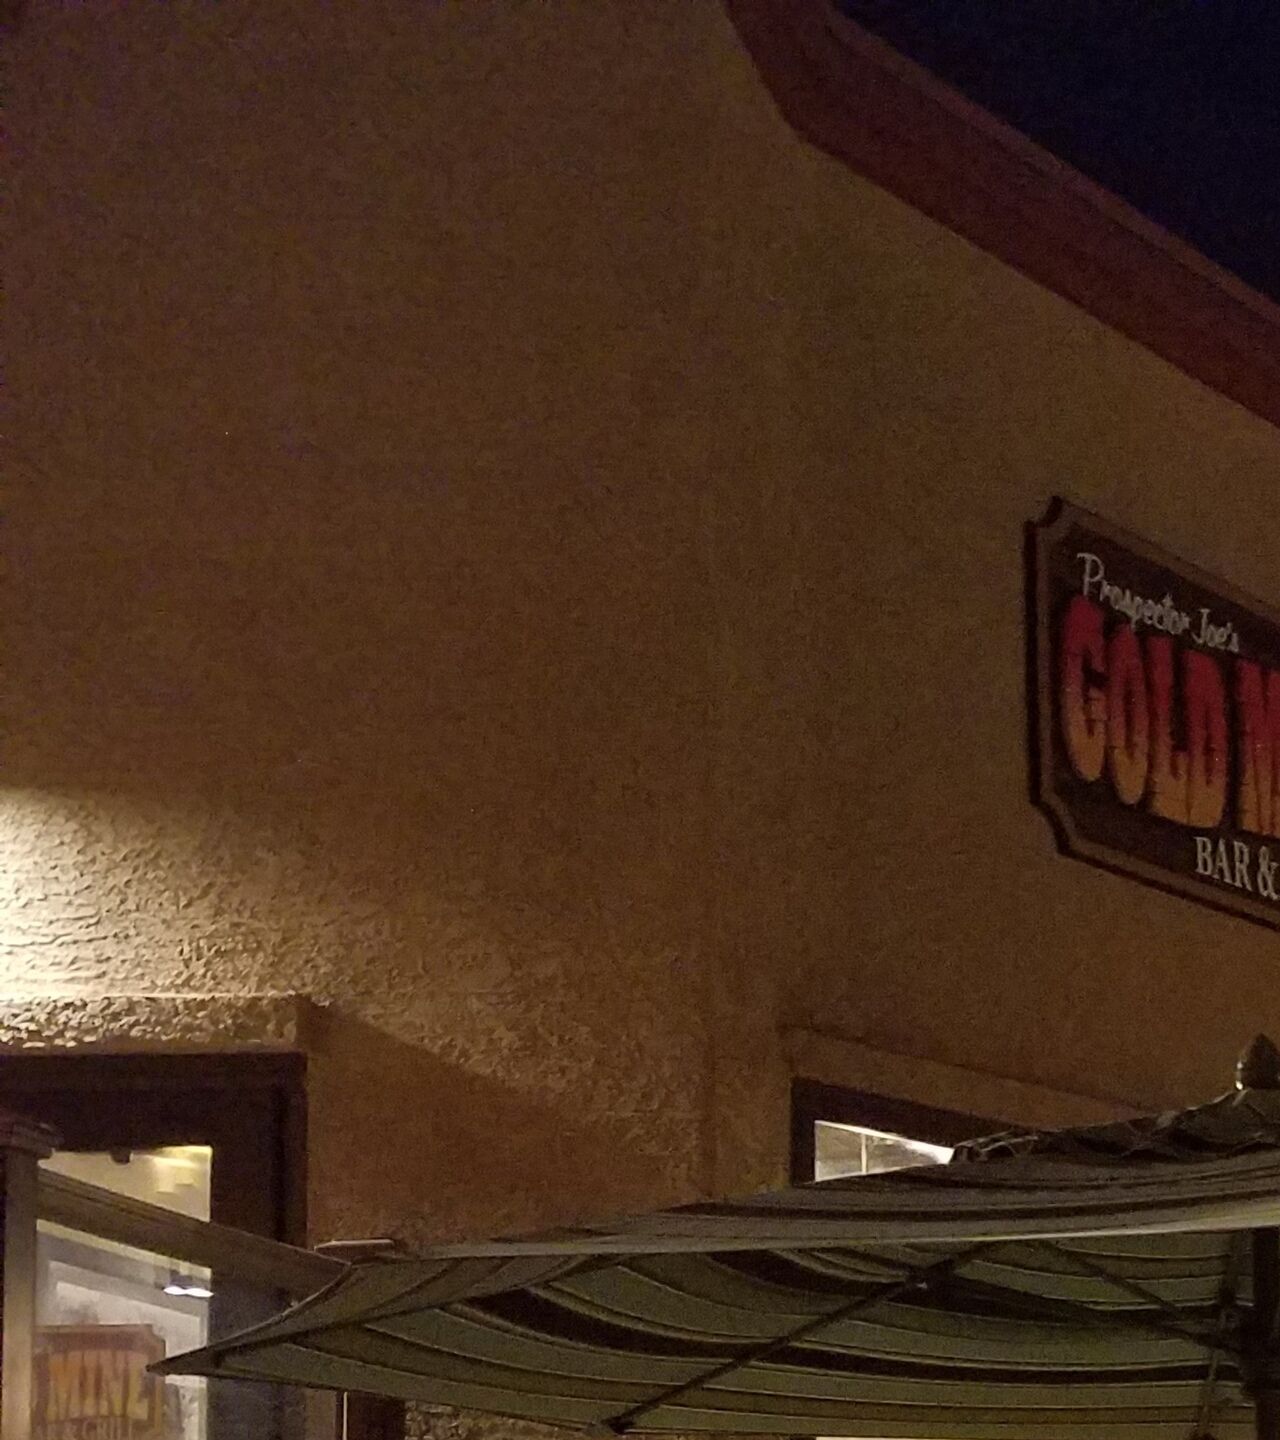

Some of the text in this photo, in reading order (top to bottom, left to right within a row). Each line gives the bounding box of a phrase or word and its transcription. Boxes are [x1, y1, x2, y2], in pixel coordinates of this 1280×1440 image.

[1192, 608, 1239, 653] Joe's
[1062, 594, 1229, 829] GOLD
[1194, 836, 1253, 892] BAR
[1257, 845, 1279, 900] &
